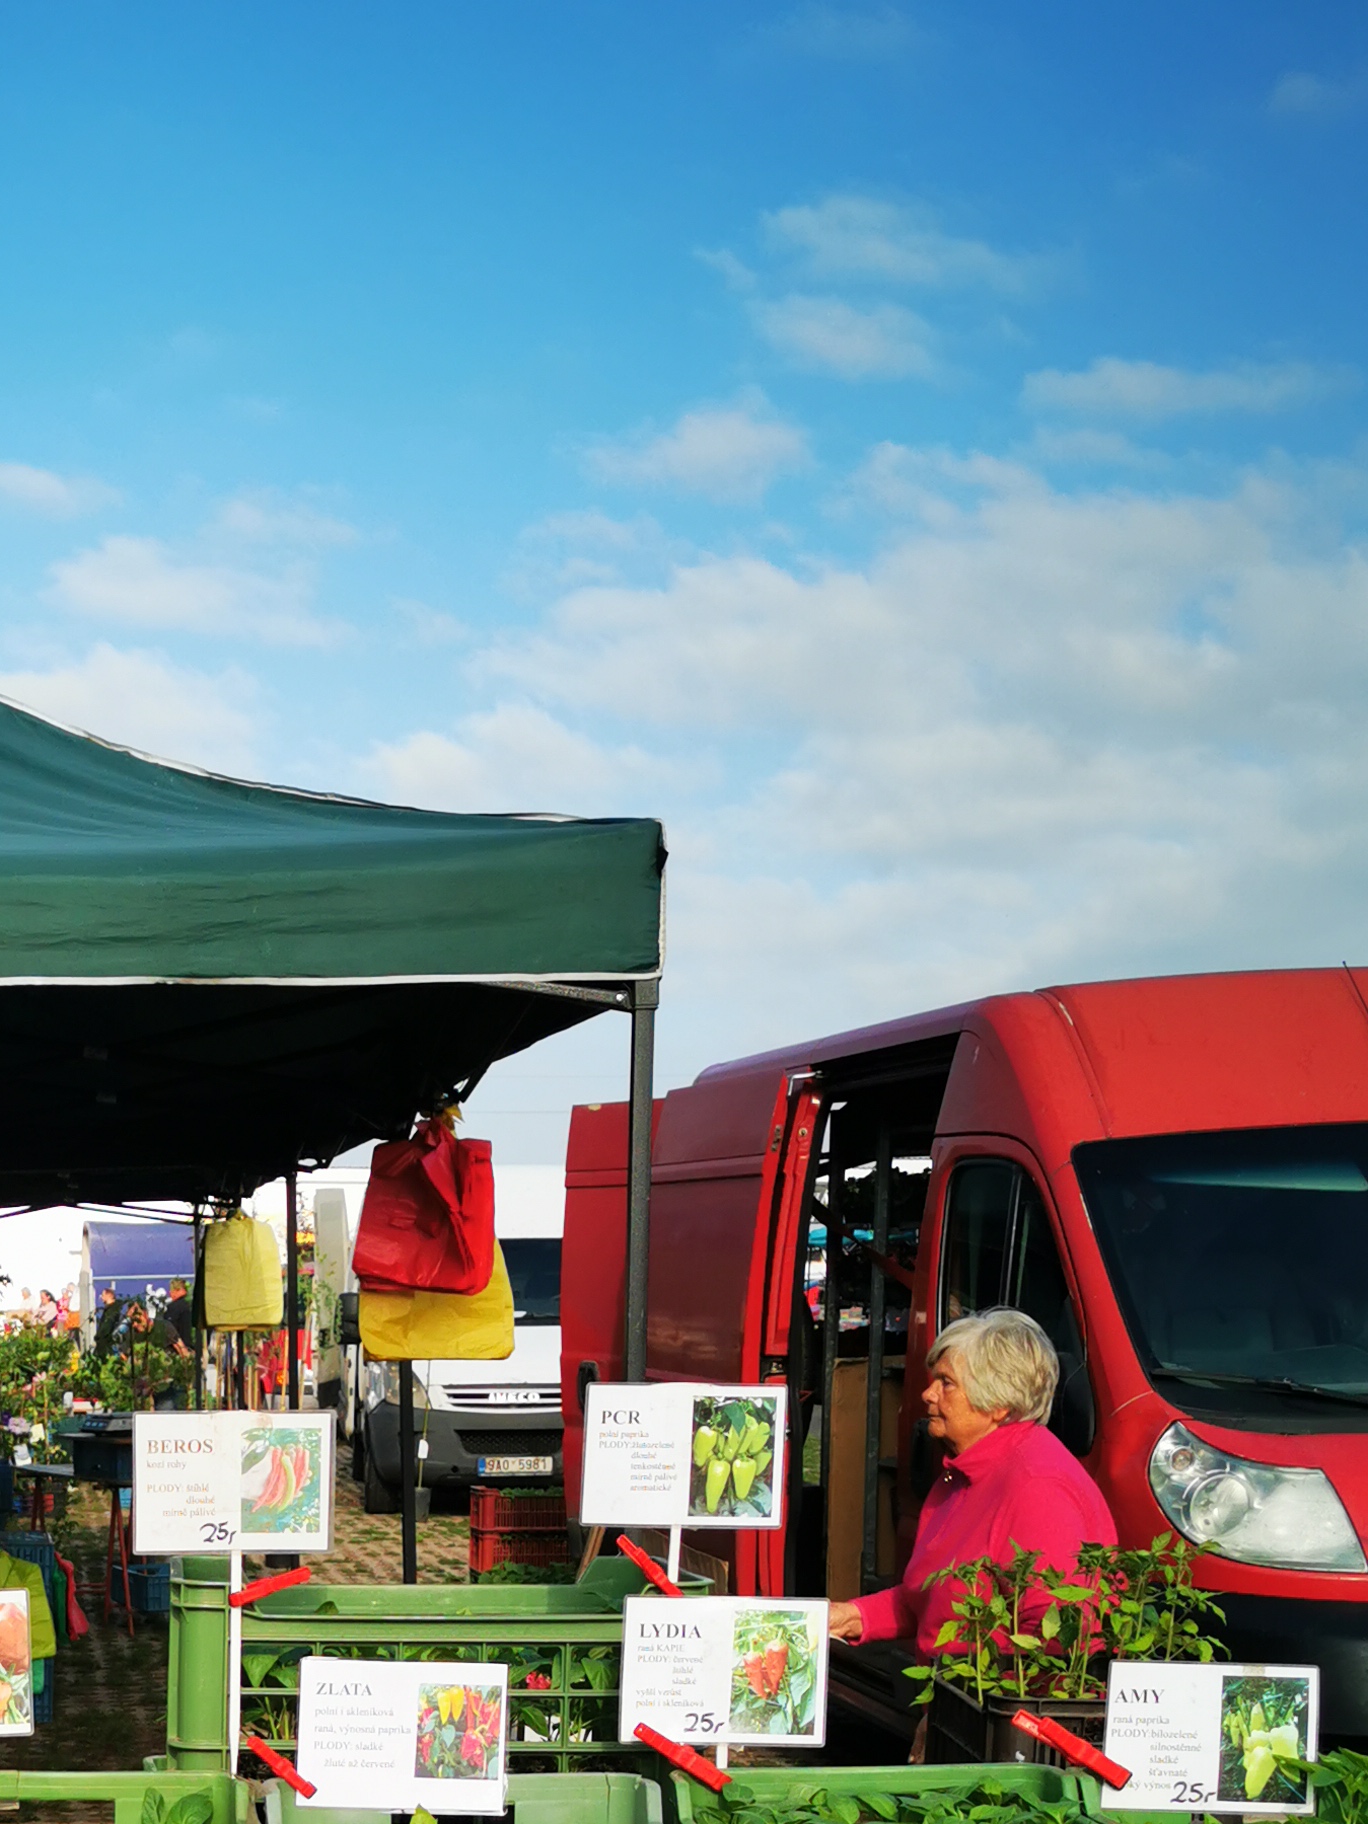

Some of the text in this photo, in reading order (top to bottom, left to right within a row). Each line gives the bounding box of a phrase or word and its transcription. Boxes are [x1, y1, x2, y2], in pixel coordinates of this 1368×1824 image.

[601, 1410, 641, 1425] PCR
[621, 1431, 649, 1440] paprika
[147, 1439, 213, 1454] BEROS
[167, 1460, 187, 1470] rohy
[518, 1458, 547, 1470] 5981
[147, 1484, 184, 1493] PLODY:
[630, 1483, 672, 1491] aromatické
[186, 1496, 216, 1505] dlouhé
[190, 1508, 216, 1518] pálivé
[640, 1623, 702, 1639] LYDIA
[637, 1655, 671, 1664] PLODY:
[316, 1682, 372, 1696] ZLATA
[1115, 1688, 1165, 1704] AMY
[663, 1699, 704, 1708] skleníková
[315, 1707, 339, 1718] polní
[346, 1707, 395, 1717] skleníková
[1113, 1716, 1170, 1726] raná paprika
[339, 1725, 376, 1736] výnosná
[378, 1726, 411, 1736] paprika
[314, 1741, 383, 1751] PLODY: sladké
[1150, 1742, 1202, 1752] silnostěnné
[360, 1758, 396, 1769] červené
[1149, 1755, 1179, 1765] sladké
